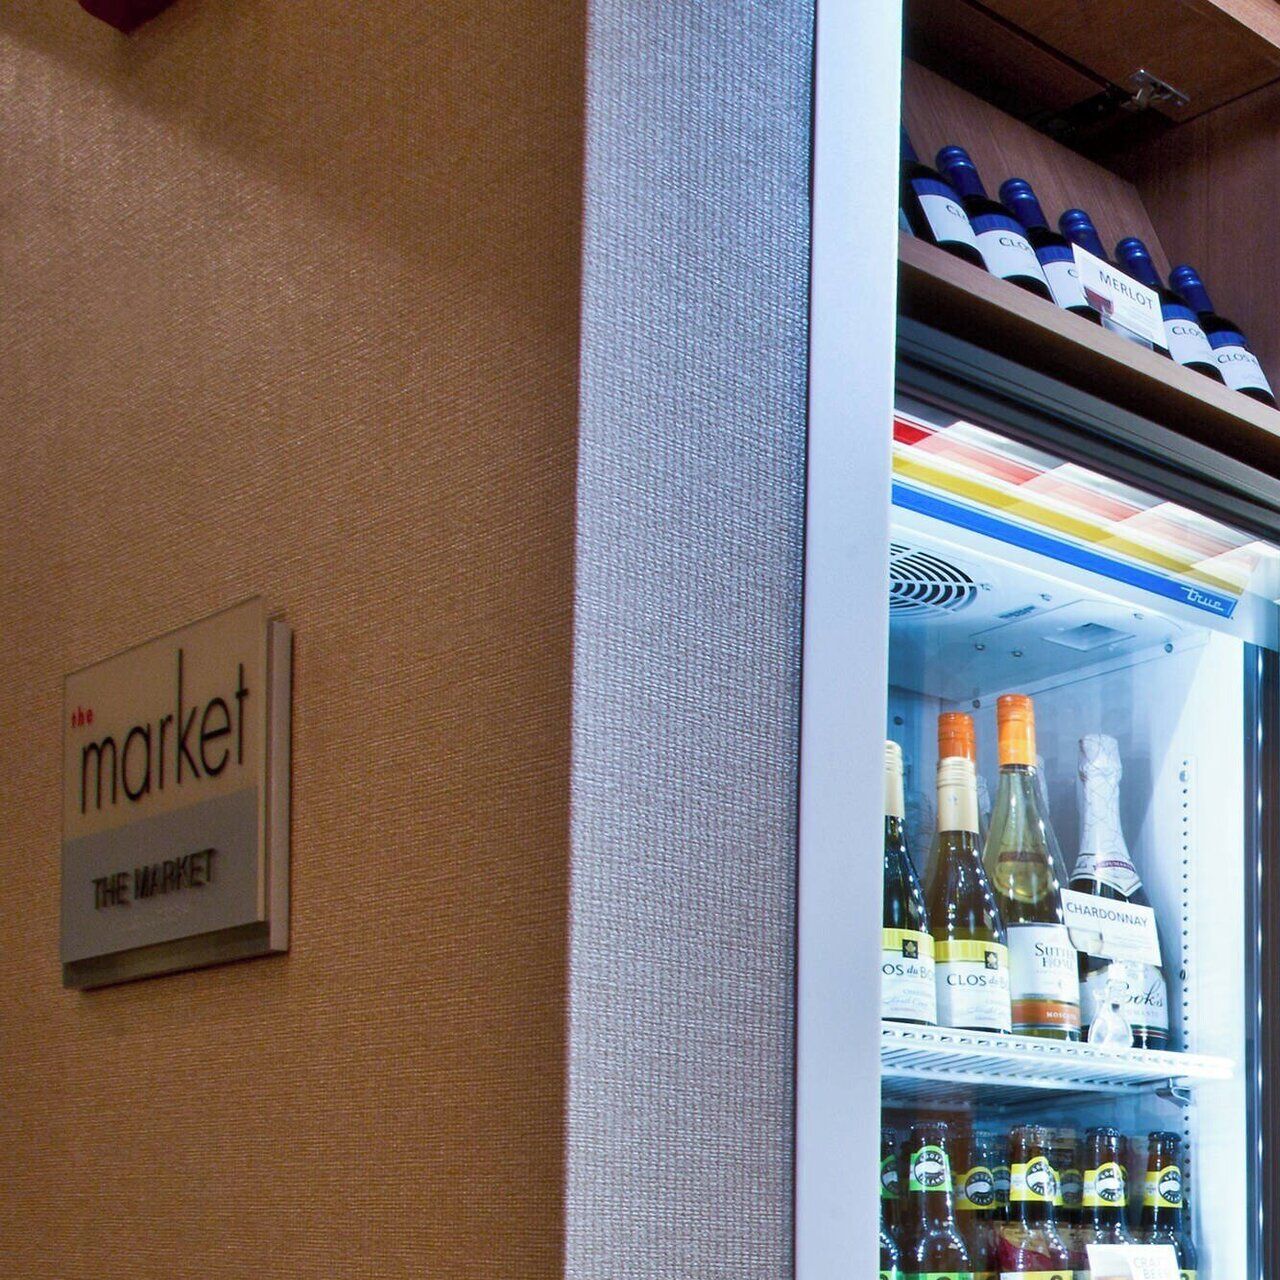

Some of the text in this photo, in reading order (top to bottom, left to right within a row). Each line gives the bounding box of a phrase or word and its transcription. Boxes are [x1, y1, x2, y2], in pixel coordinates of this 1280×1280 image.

[1099, 270, 1152, 309] MERLOT
[71, 706, 93, 728] the
[80, 647, 249, 815] market
[91, 847, 216, 911] THE MARKET
[1066, 901, 1149, 928] CHARDONNAY
[946, 973, 988, 987] CLOS
